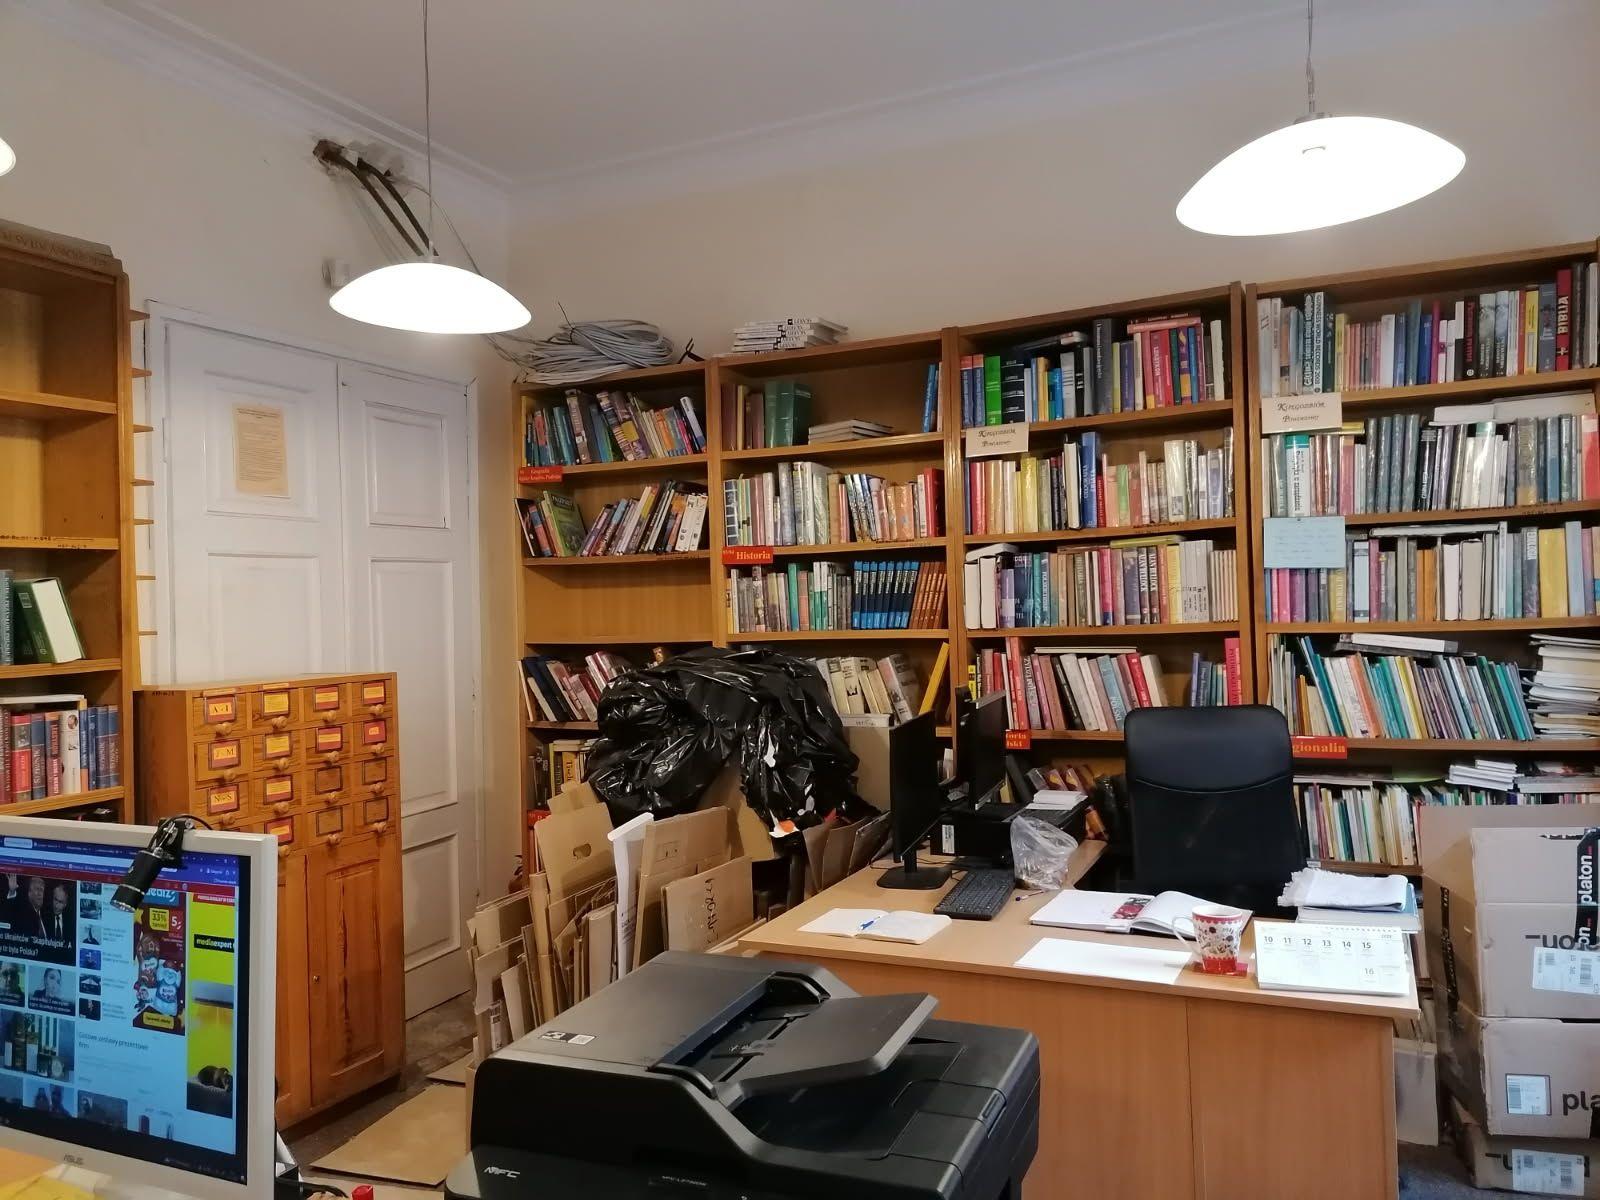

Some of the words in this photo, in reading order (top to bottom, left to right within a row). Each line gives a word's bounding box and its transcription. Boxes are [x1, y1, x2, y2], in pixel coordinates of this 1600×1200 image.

[1557, 296, 1568, 334] BIBLIA
[736, 551, 771, 560] Historia
[1139, 567, 1147, 592] BULLOCK
[1149, 567, 1157, 592] BULLOCK
[1293, 741, 1346, 754] gionalia
[1578, 855, 1598, 906] platon
[196, 937, 232, 951] mediaexpert
[1303, 938, 1312, 946] 12
[1364, 967, 1375, 975] 16
[483, 1166, 521, 1179] MFC
